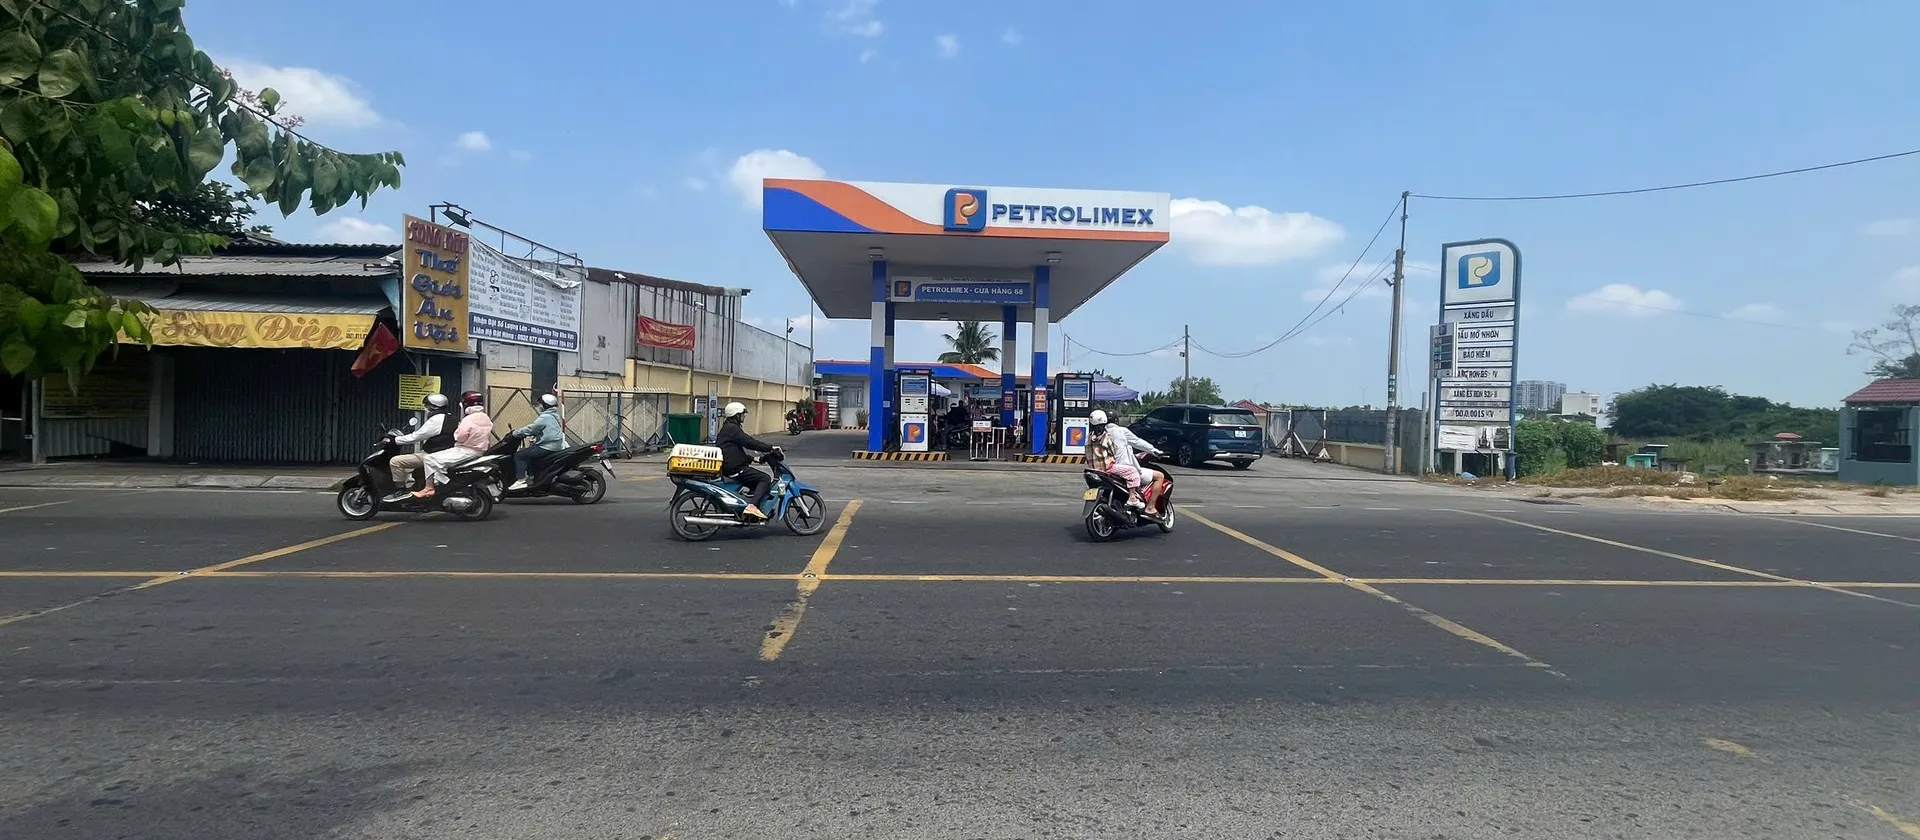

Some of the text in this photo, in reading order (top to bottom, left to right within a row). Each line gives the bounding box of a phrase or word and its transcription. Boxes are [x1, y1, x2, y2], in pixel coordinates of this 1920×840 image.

[992, 203, 1153, 225] PETROLIMEX
[408, 221, 441, 248] SONG
[921, 286, 969, 294] PETROLIMEX
[991, 286, 1012, 295] HÀNG
[255, 314, 344, 349] Điệp
